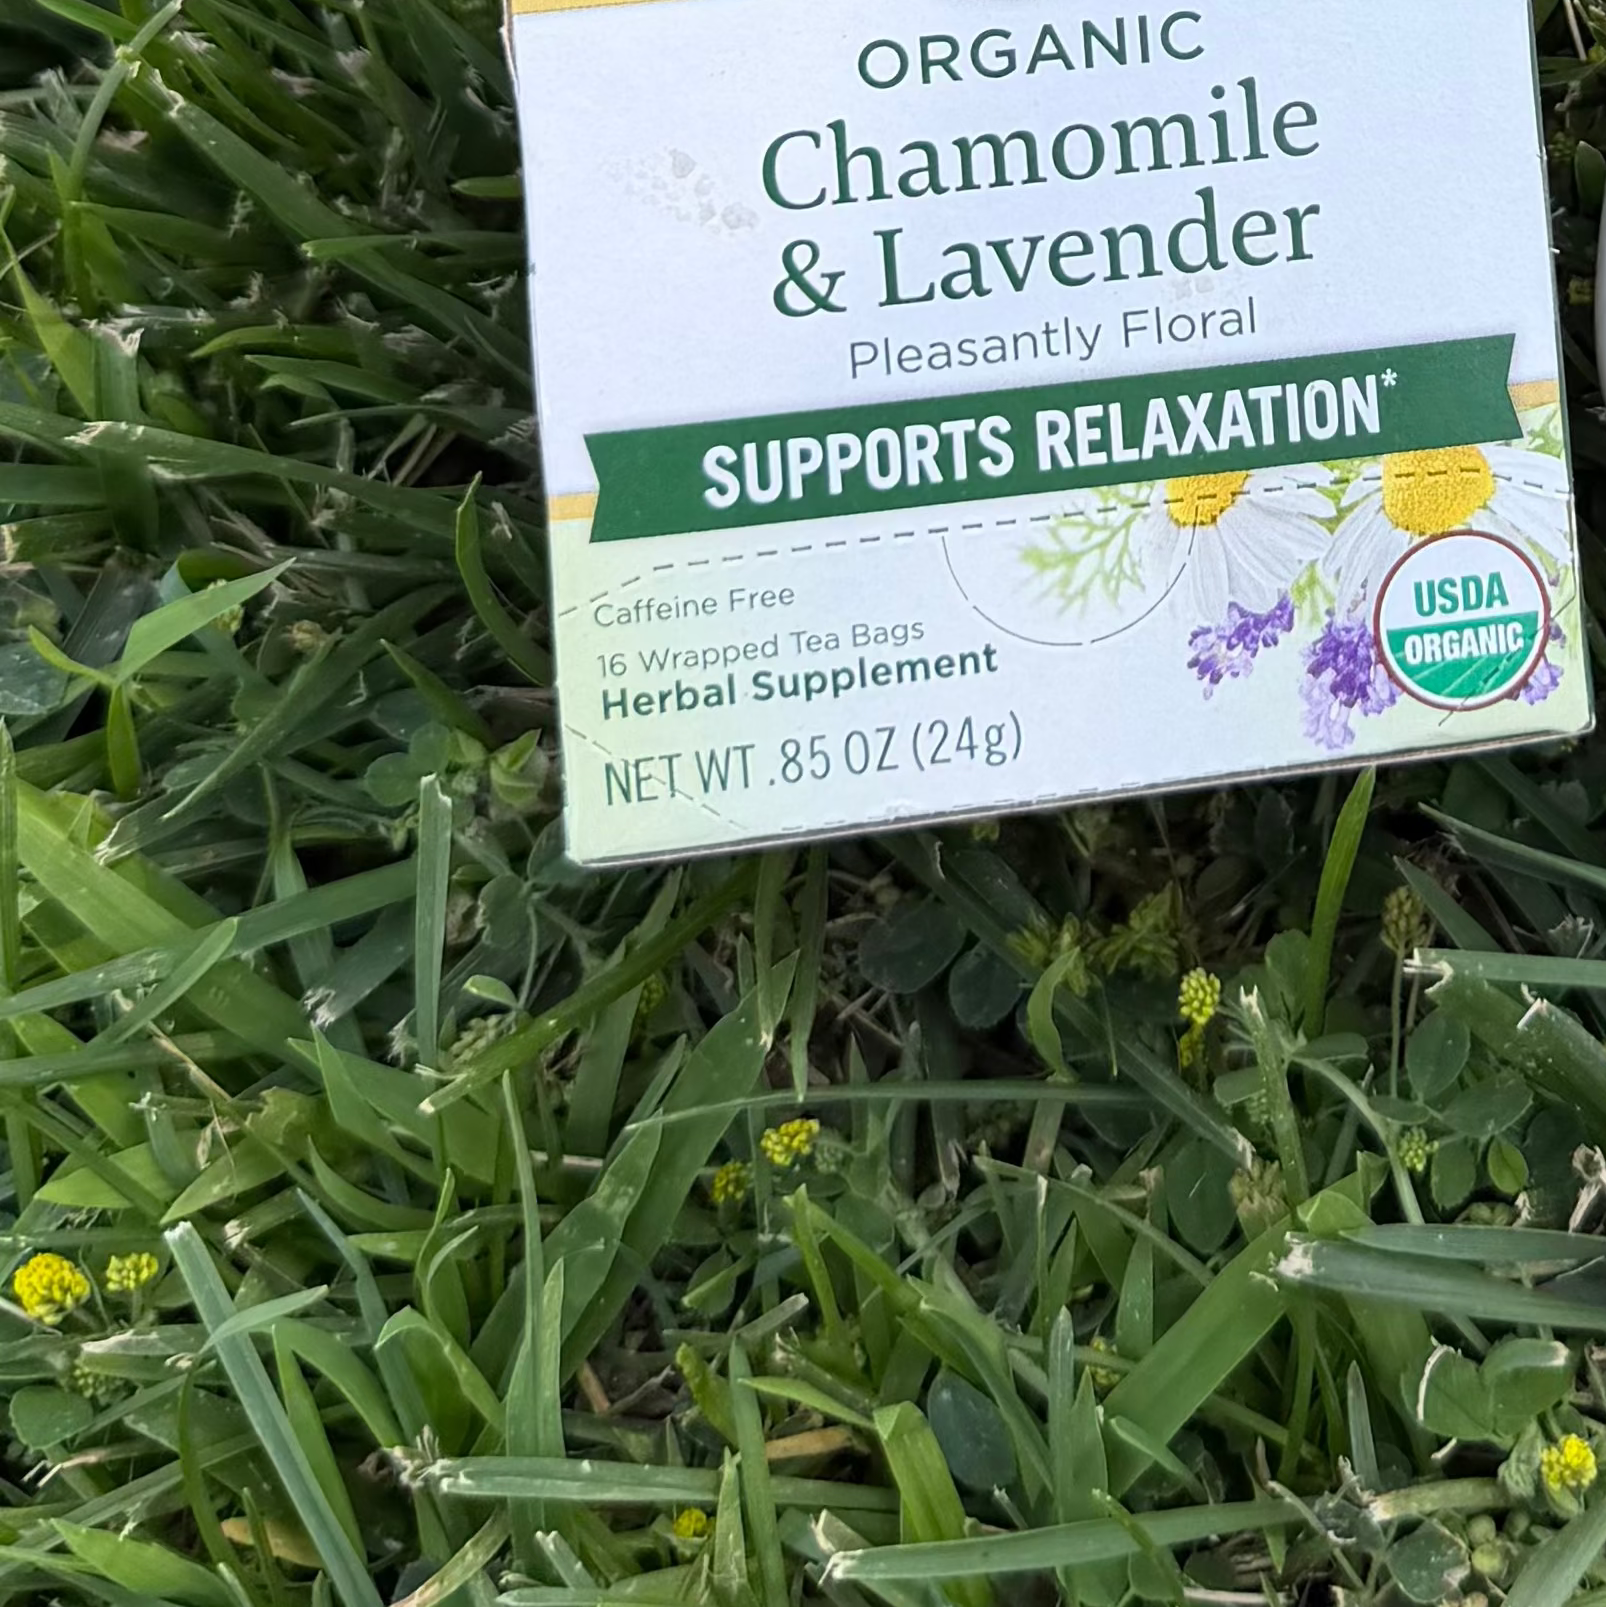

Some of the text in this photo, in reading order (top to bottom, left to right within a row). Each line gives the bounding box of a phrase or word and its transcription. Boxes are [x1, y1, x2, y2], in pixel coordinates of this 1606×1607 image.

[856, 10, 1206, 89] ORGANIC
[761, 76, 1321, 210] Chamomile
[772, 185, 1321, 318] & Lavender
[849, 296, 1257, 379] Pleasantly Floral
[702, 415, 1015, 510] SUPPORTS
[593, 586, 796, 628] Caffeine Free
[1413, 571, 1509, 617] USDA
[597, 620, 925, 679] 16 Wrapped Tea Bags
[601, 642, 999, 720] Herbal Supplement
[1404, 621, 1525, 666] ORGANIC
[604, 709, 1023, 806] NET WT .85 OZ (24g)
